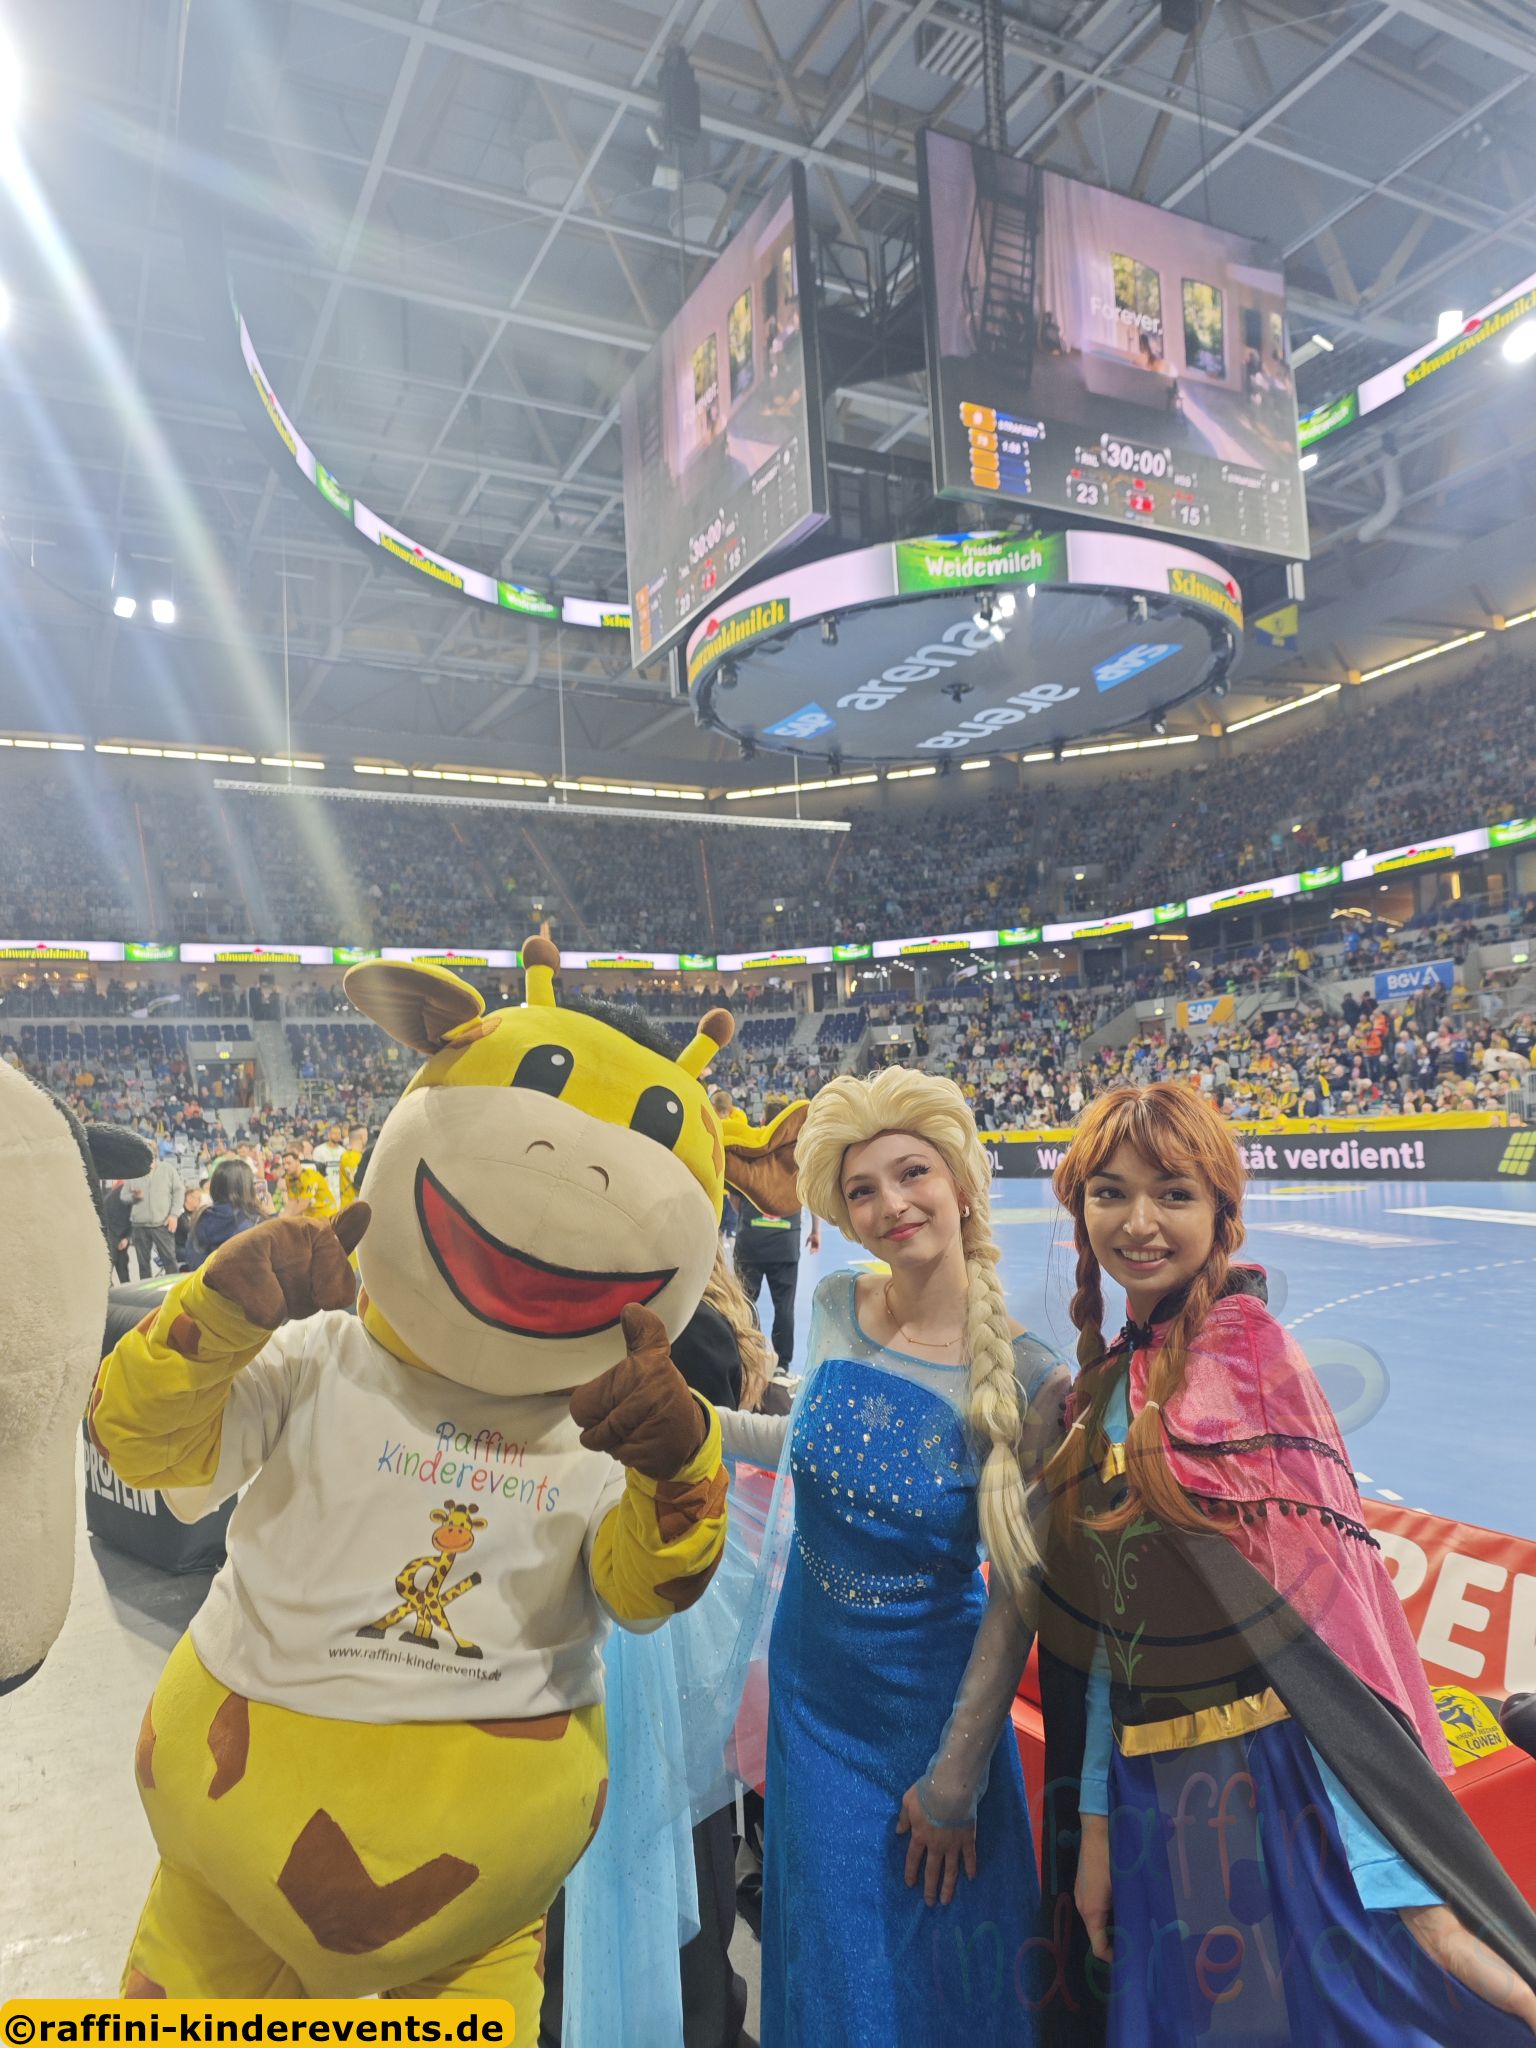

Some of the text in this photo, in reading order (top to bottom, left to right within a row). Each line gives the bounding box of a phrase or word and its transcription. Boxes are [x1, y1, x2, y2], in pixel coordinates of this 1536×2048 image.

[1090, 296, 1163, 336] Forever.
[1107, 441, 1166, 478] 30:00
[1076, 482, 1099, 506] 23
[1179, 505, 1201, 527] 15
[924, 549, 1042, 578] Weidemilch
[836, 620, 1010, 711] arena
[1096, 644, 1170, 682] SAP
[916, 683, 1080, 749] arena
[1387, 971, 1420, 990] BGV
[1188, 1002, 1213, 1023] SAP
[1283, 1139, 1426, 1170] verdient!
[436, 1421, 527, 1468] Raffini
[378, 1440, 559, 1512] Kinderevents
[329, 1646, 502, 1682] www.raffini-kinderevents.de
